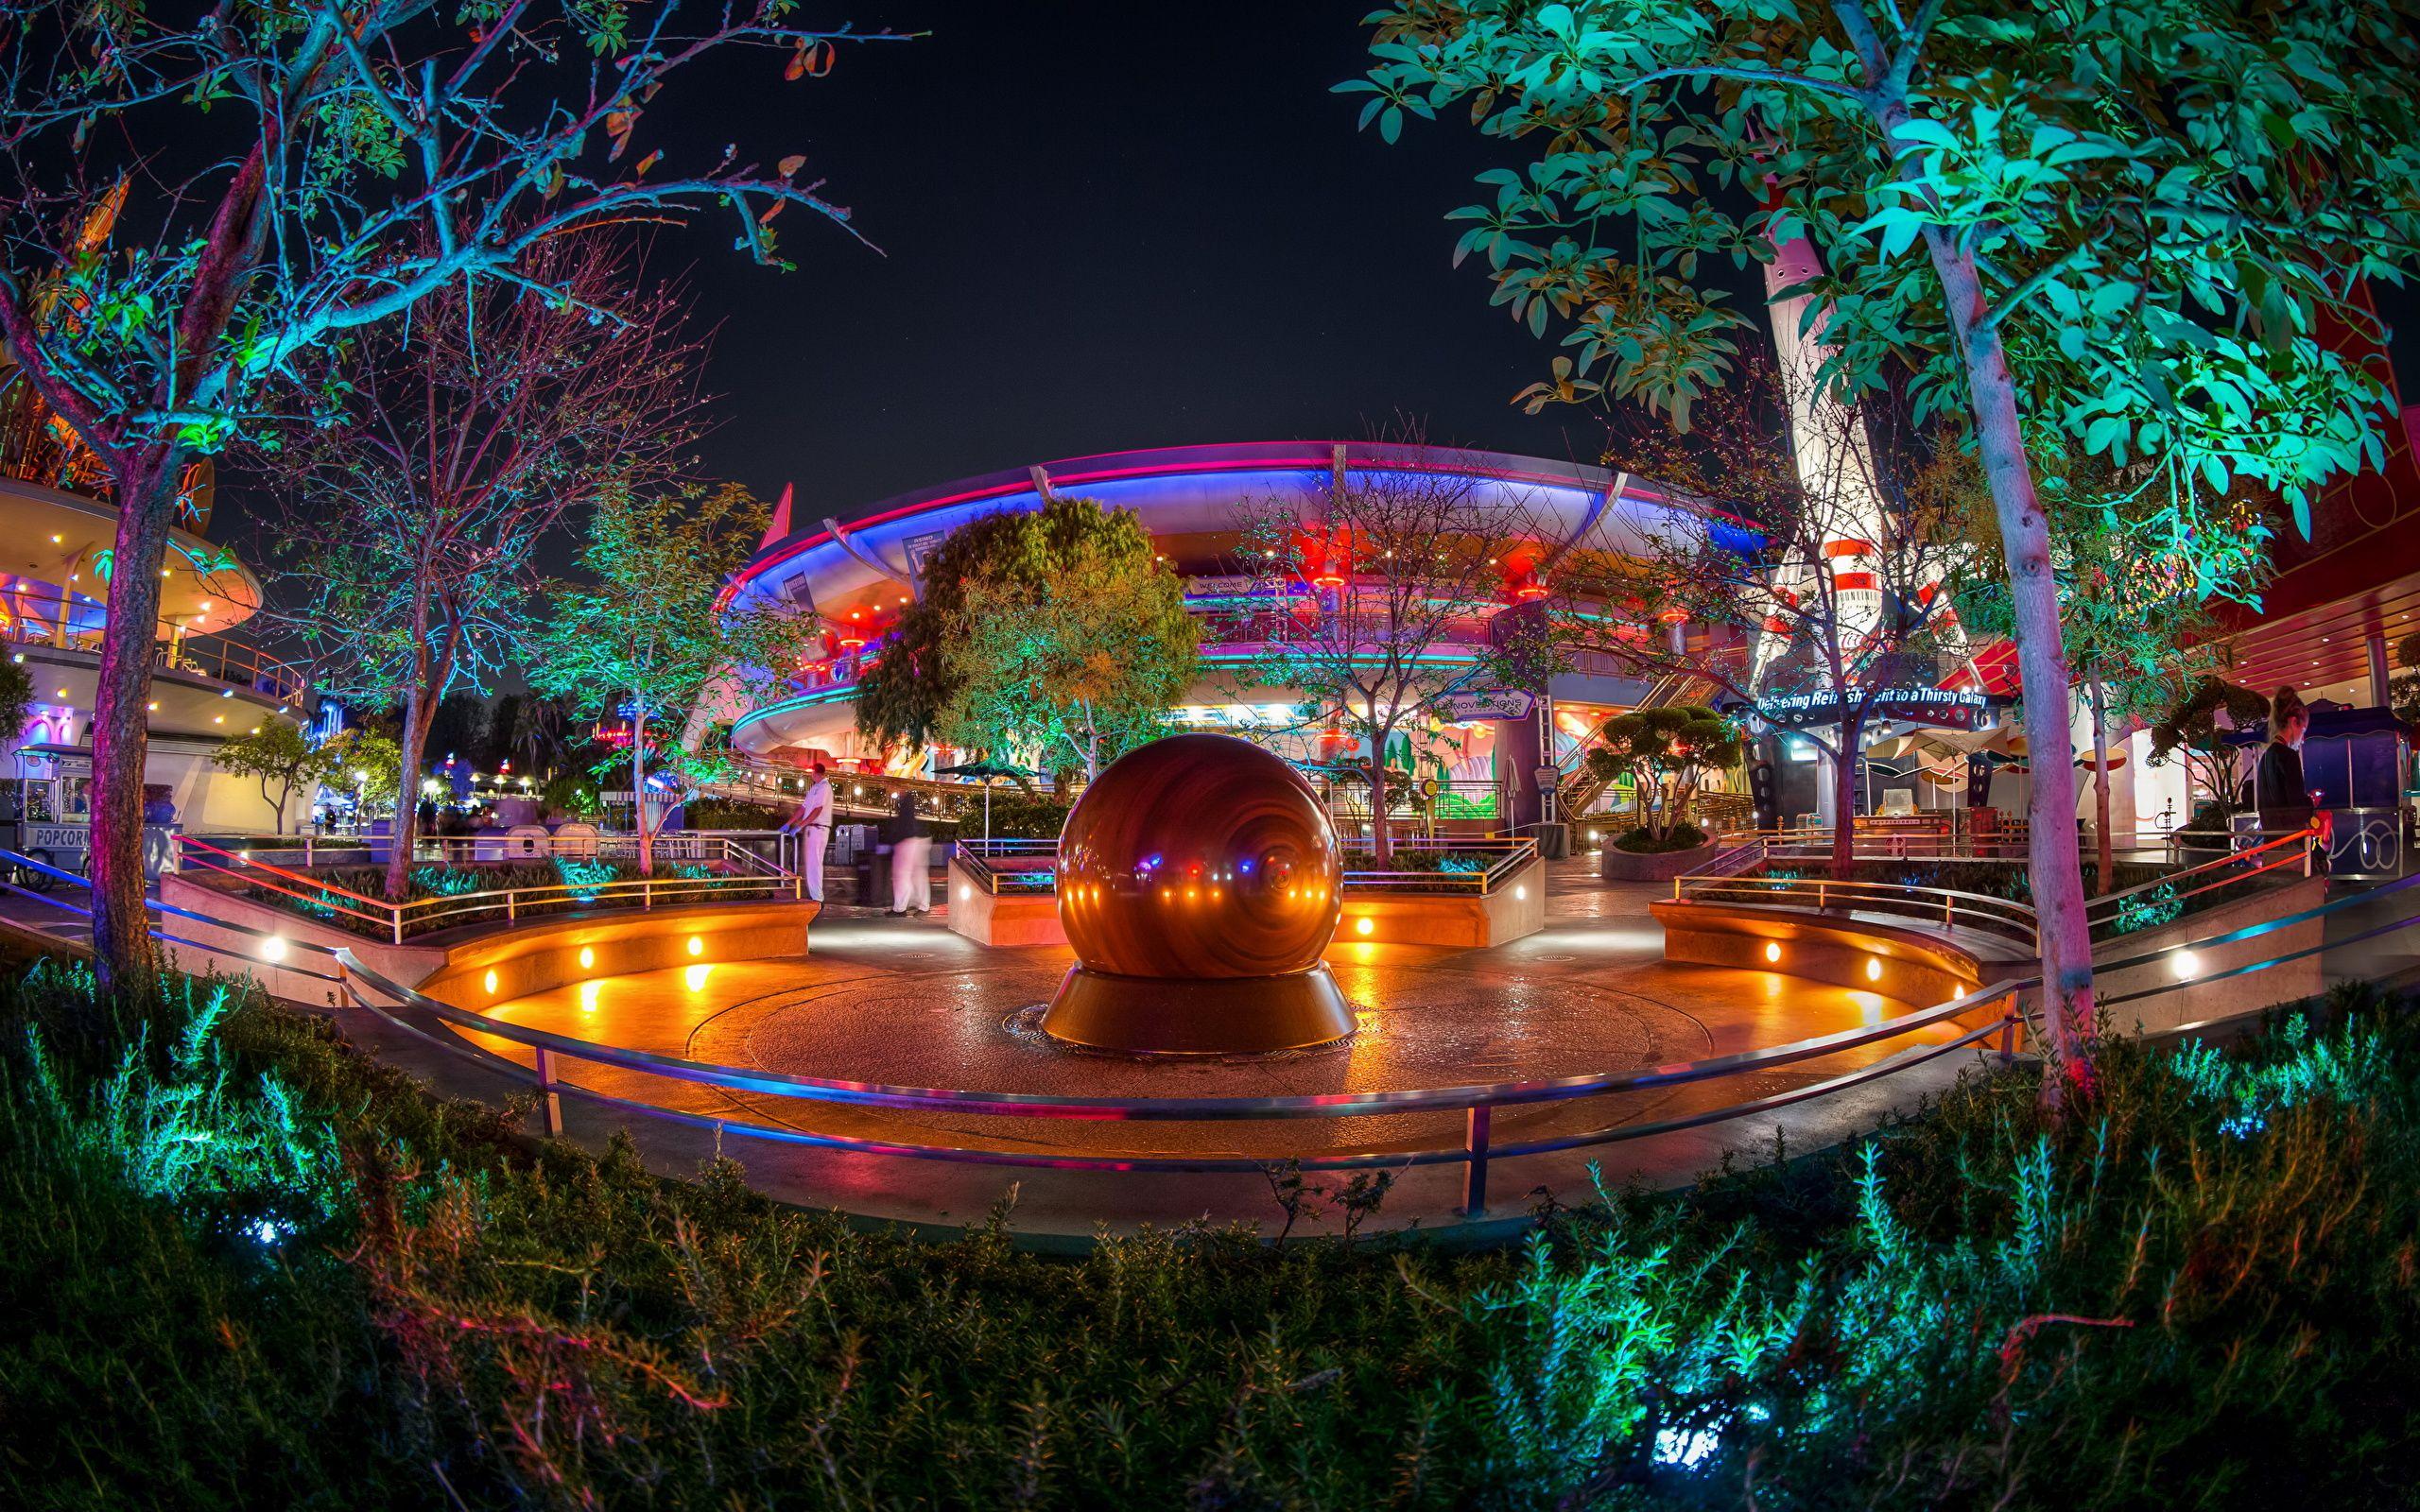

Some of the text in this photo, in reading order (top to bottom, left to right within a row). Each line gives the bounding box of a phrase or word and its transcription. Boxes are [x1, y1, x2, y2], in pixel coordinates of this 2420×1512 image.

[1896, 690, 1909, 702] to
[1910, 690, 1919, 702] a
[1920, 687, 1958, 706] Thirsty
[1959, 689, 1987, 710] Galaxy
